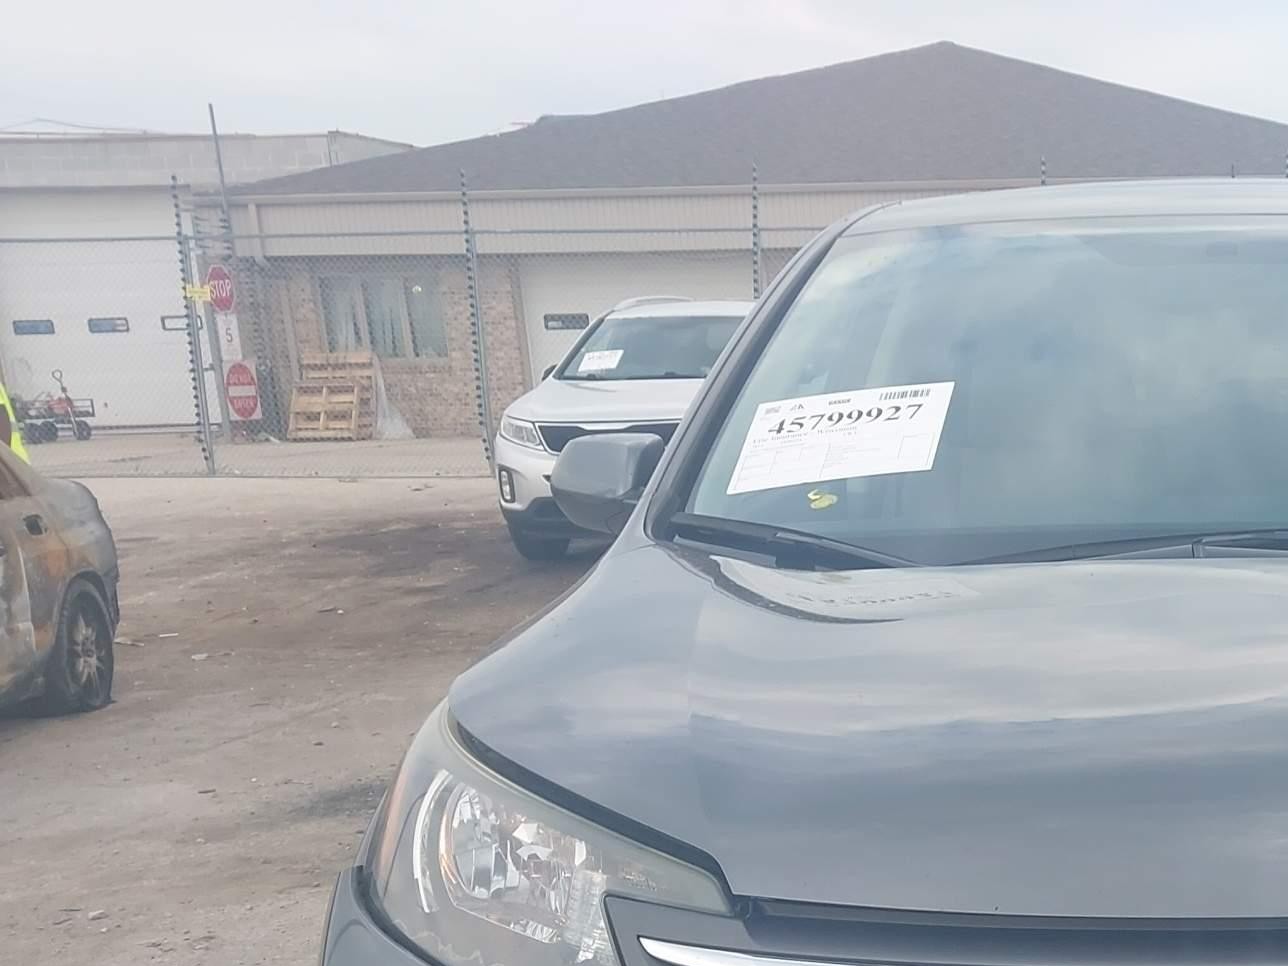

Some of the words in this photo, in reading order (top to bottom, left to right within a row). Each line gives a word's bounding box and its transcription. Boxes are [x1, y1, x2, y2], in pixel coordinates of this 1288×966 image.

[208, 279, 232, 298] STOP
[225, 327, 233, 343] 5
[767, 403, 924, 435] 45799927
